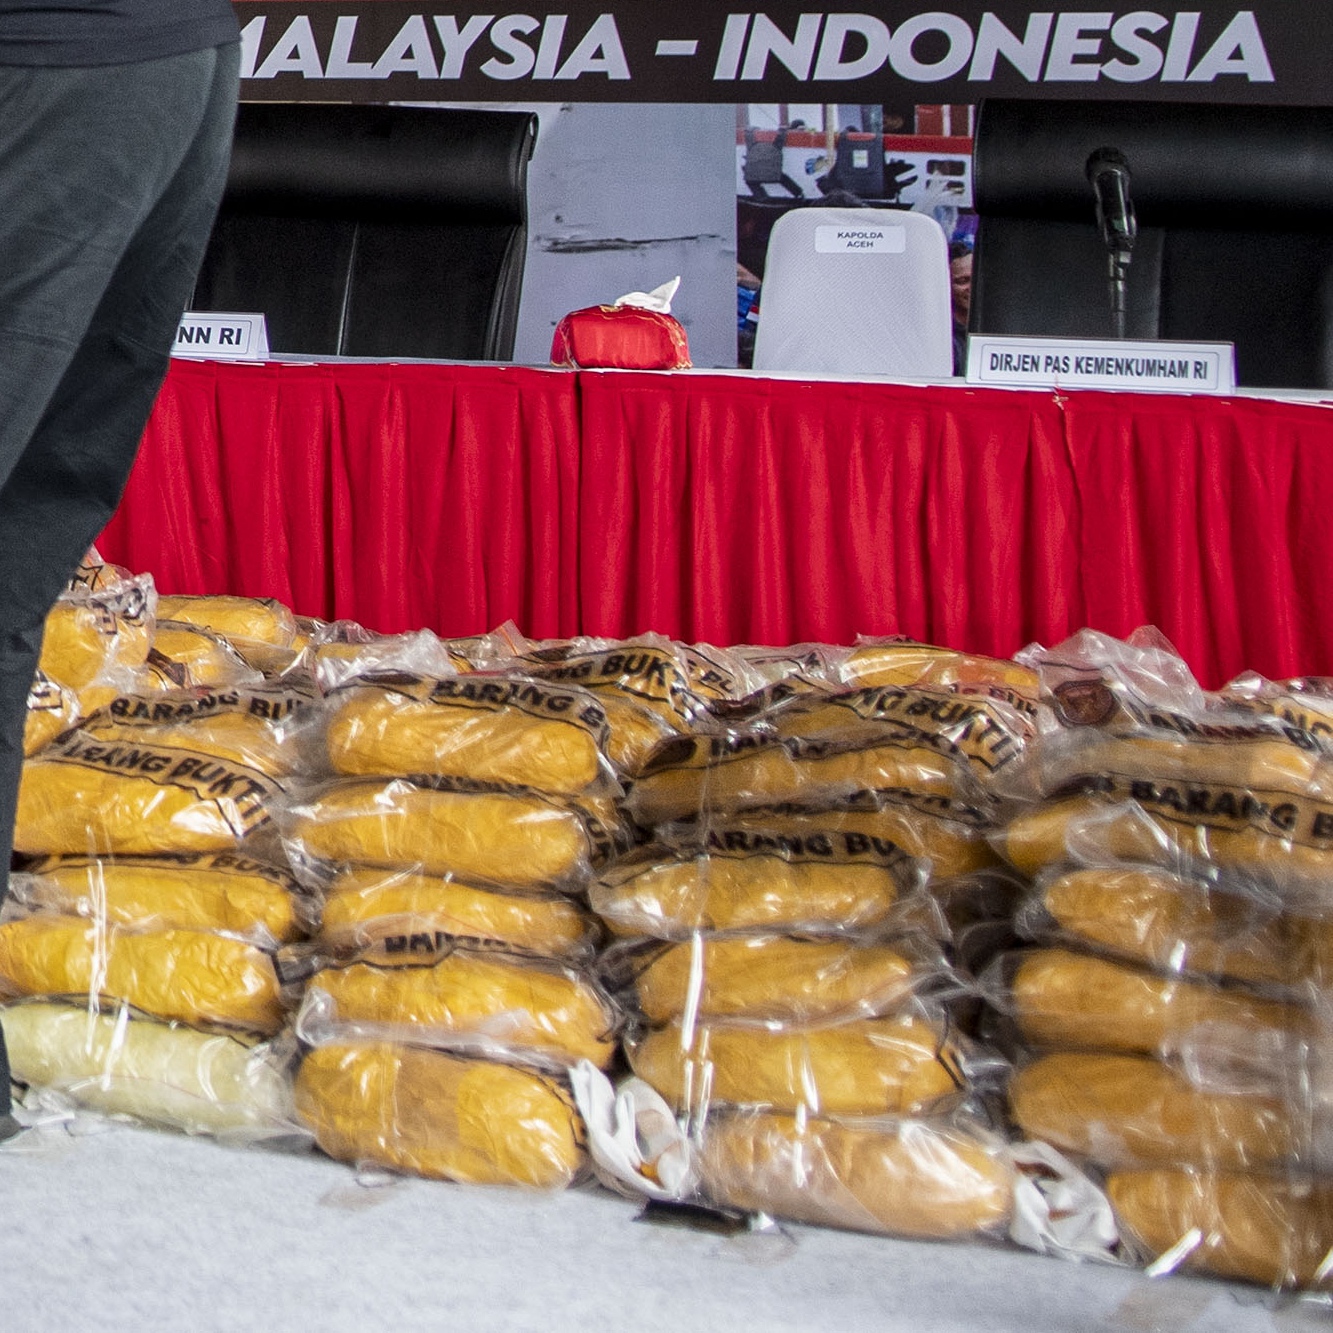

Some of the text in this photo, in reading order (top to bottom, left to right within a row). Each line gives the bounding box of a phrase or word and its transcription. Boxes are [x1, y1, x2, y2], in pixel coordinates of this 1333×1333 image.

[714, 11, 1275, 82] INDONESIA
[218, 327, 242, 345] RI
[990, 353, 1208, 379] DIRJEN PAS KEMENKUMHAM RI
